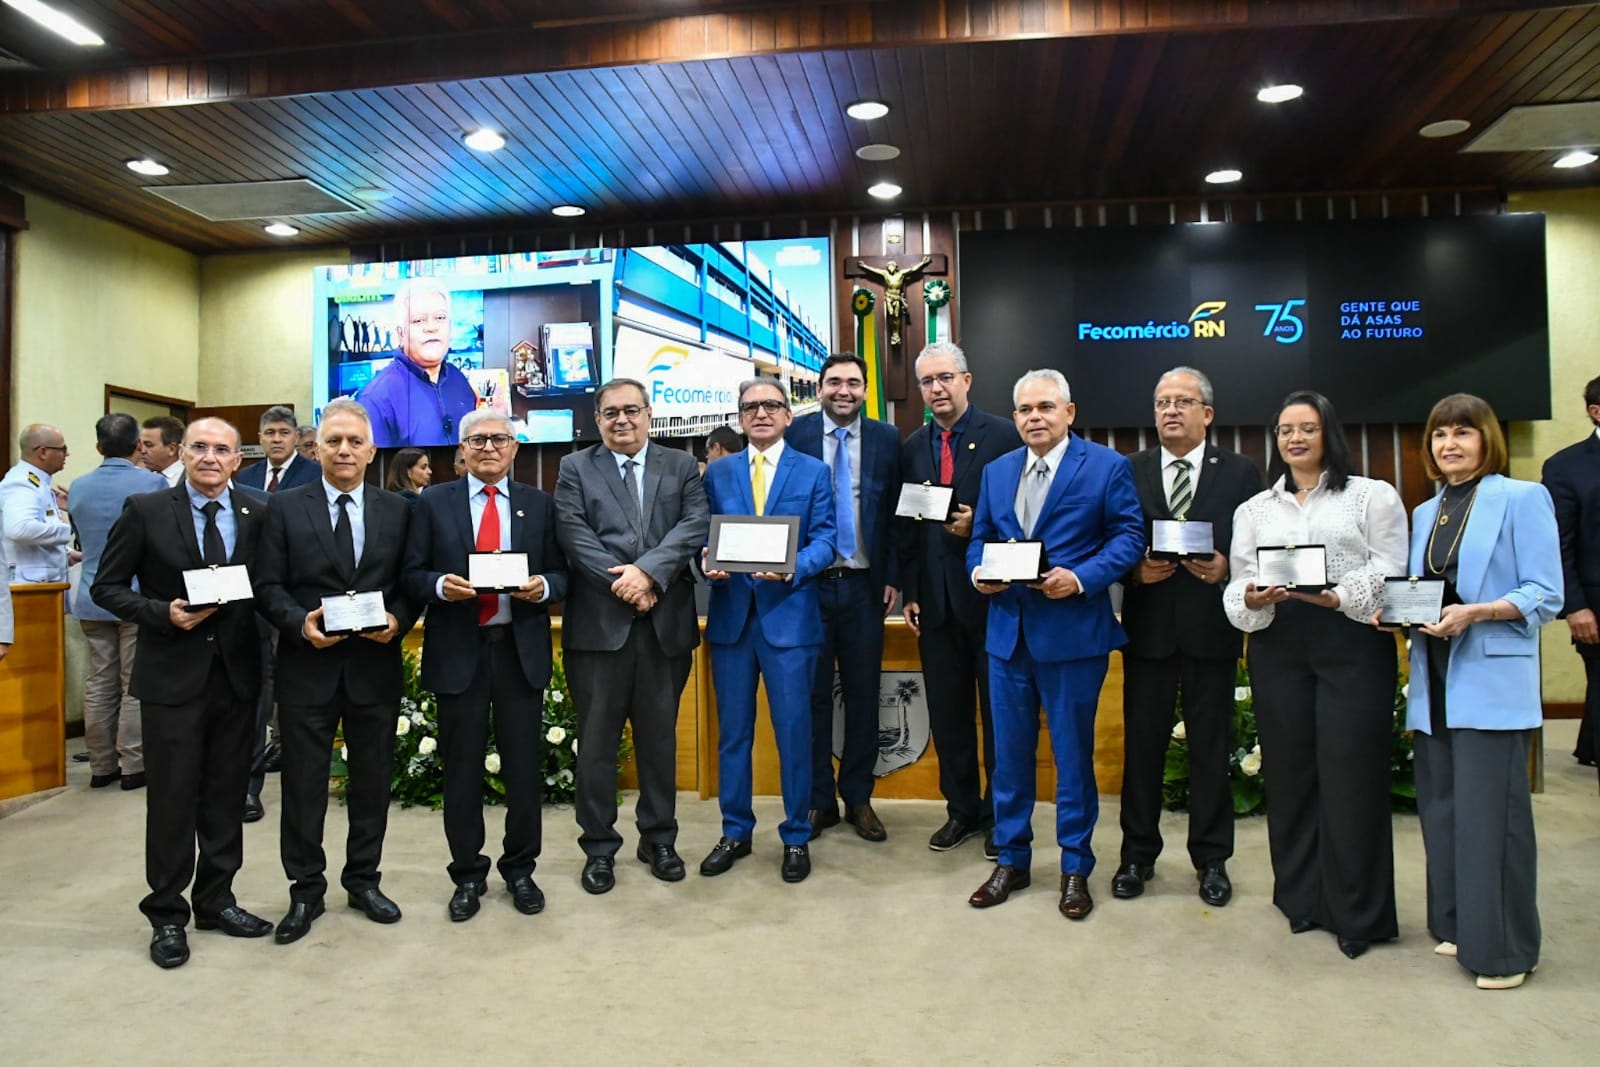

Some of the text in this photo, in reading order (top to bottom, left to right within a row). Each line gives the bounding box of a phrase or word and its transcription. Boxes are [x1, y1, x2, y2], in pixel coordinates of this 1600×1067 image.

[1340, 300, 1421, 313] GENTE QUE
[1255, 299, 1306, 344] 75
[1341, 314, 1402, 326] DÁ ASAS
[1078, 319, 1226, 340] Fecomércio RN
[1341, 327, 1423, 339] AO FUTURO
[651, 380, 733, 404] Fecomércio
